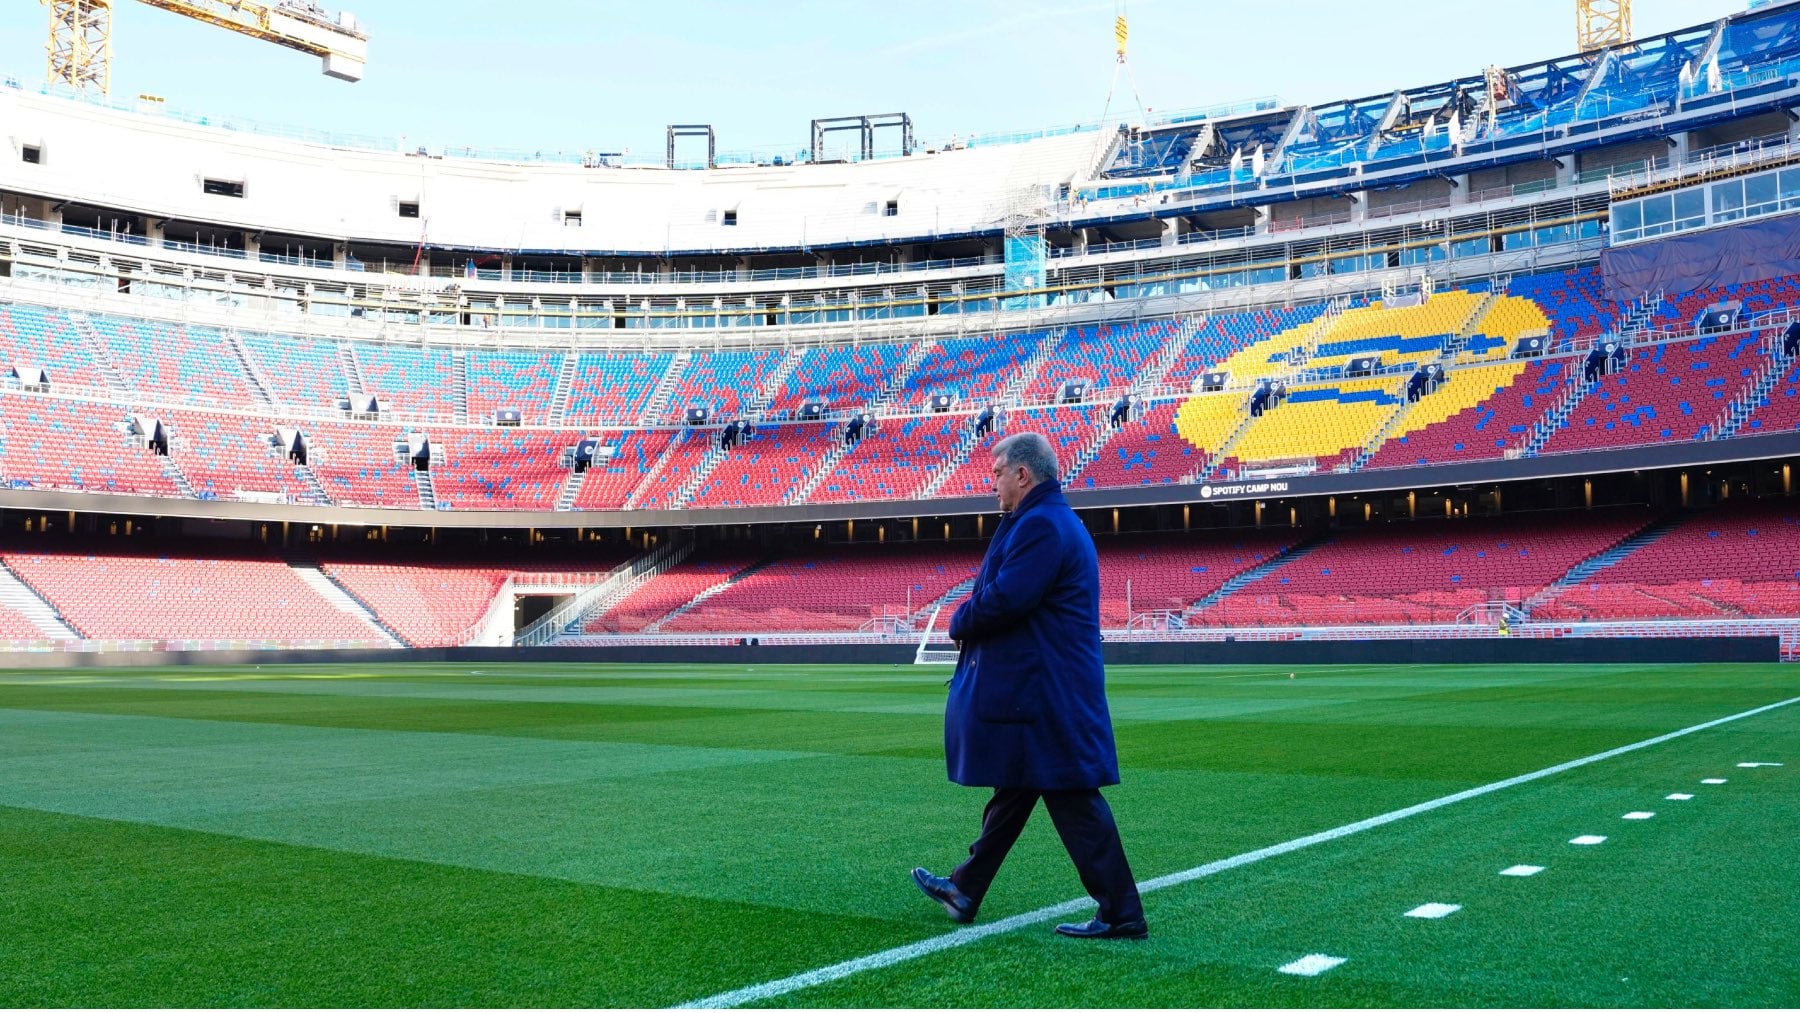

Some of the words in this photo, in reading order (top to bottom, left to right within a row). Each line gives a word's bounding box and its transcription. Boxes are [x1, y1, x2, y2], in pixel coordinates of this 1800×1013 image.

[1213, 485, 1245, 496] SPOTIFY
[1246, 484, 1269, 493] CAMP
[1270, 482, 1288, 492] NOU
